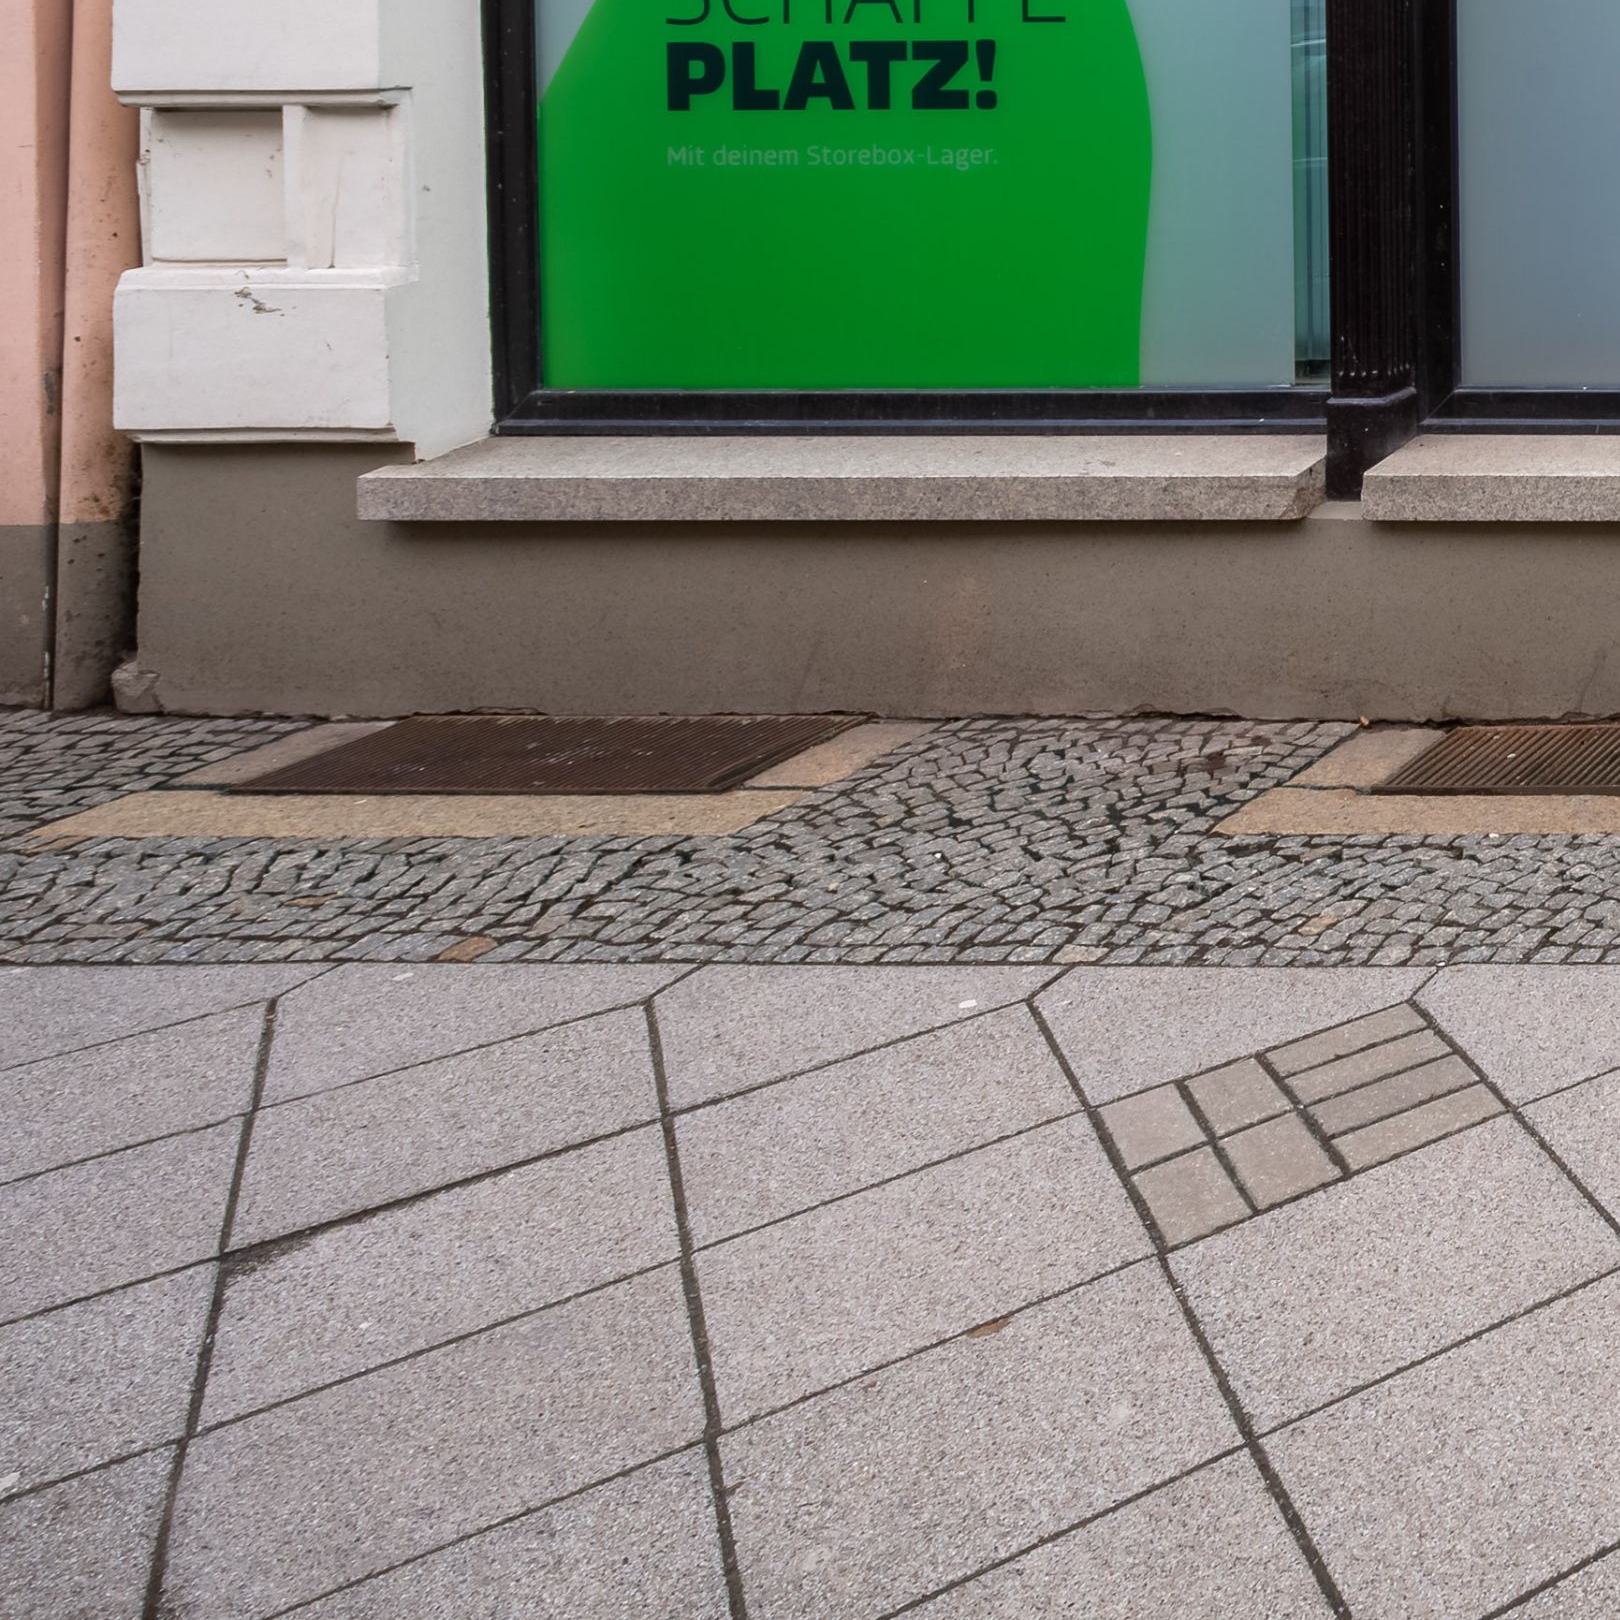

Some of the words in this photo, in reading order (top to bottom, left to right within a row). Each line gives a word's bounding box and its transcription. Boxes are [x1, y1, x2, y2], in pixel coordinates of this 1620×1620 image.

[665, 38, 998, 111] PLATZ!
[667, 145, 705, 166] Mit
[712, 144, 799, 166] deinem
[806, 144, 999, 171] Storebox-Lager.
